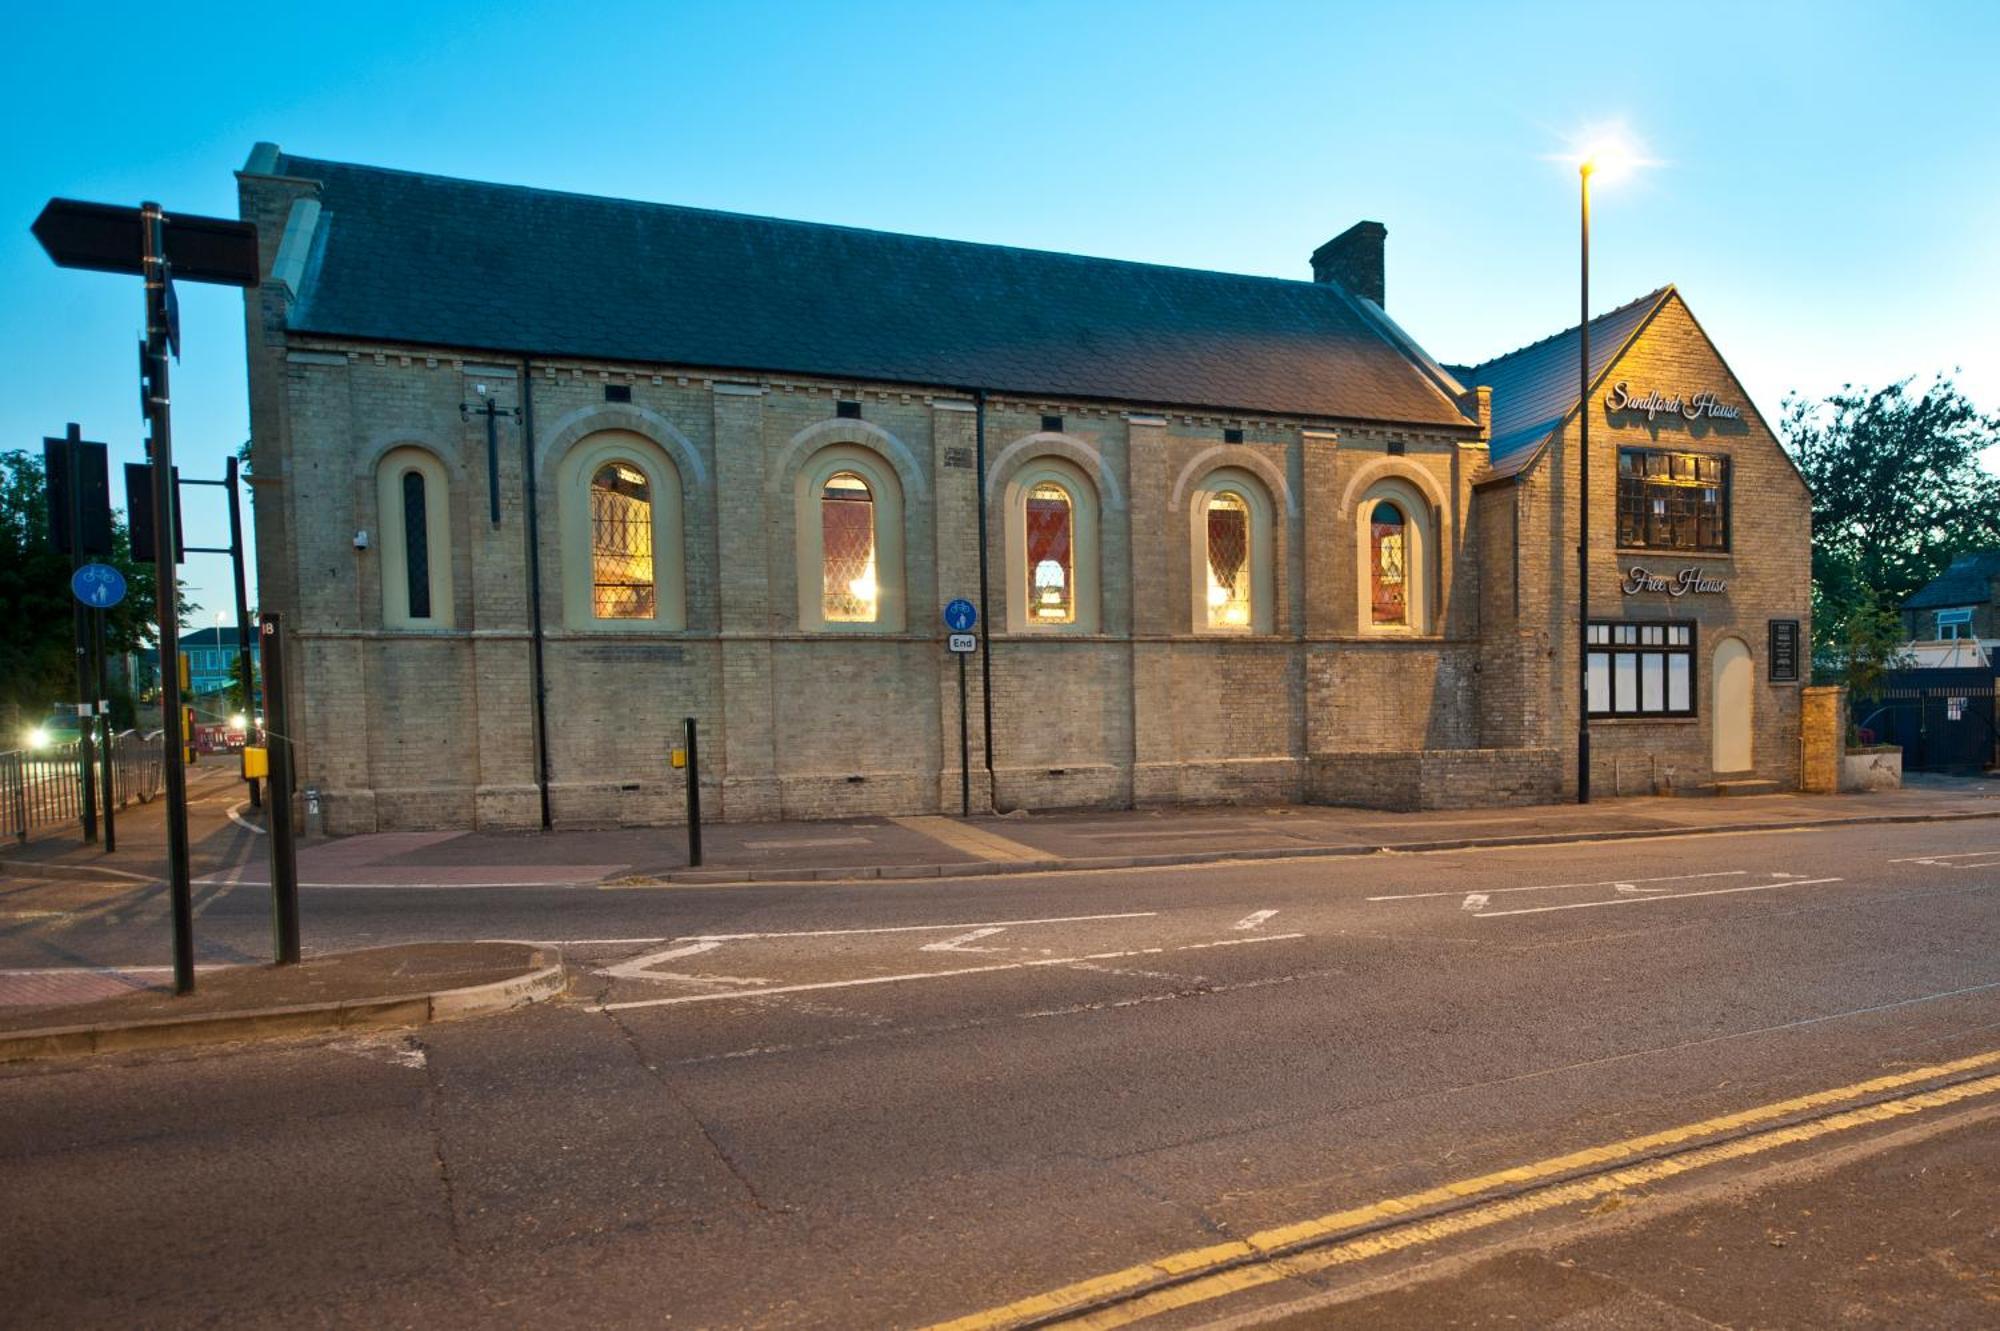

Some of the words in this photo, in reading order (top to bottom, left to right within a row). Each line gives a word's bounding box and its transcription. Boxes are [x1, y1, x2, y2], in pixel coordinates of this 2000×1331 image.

[1605, 381, 1681, 420] Sandford
[1682, 390, 1741, 419] House
[1622, 566, 1665, 594] Free
[1669, 567, 1728, 597] House
[953, 637, 973, 648] End
